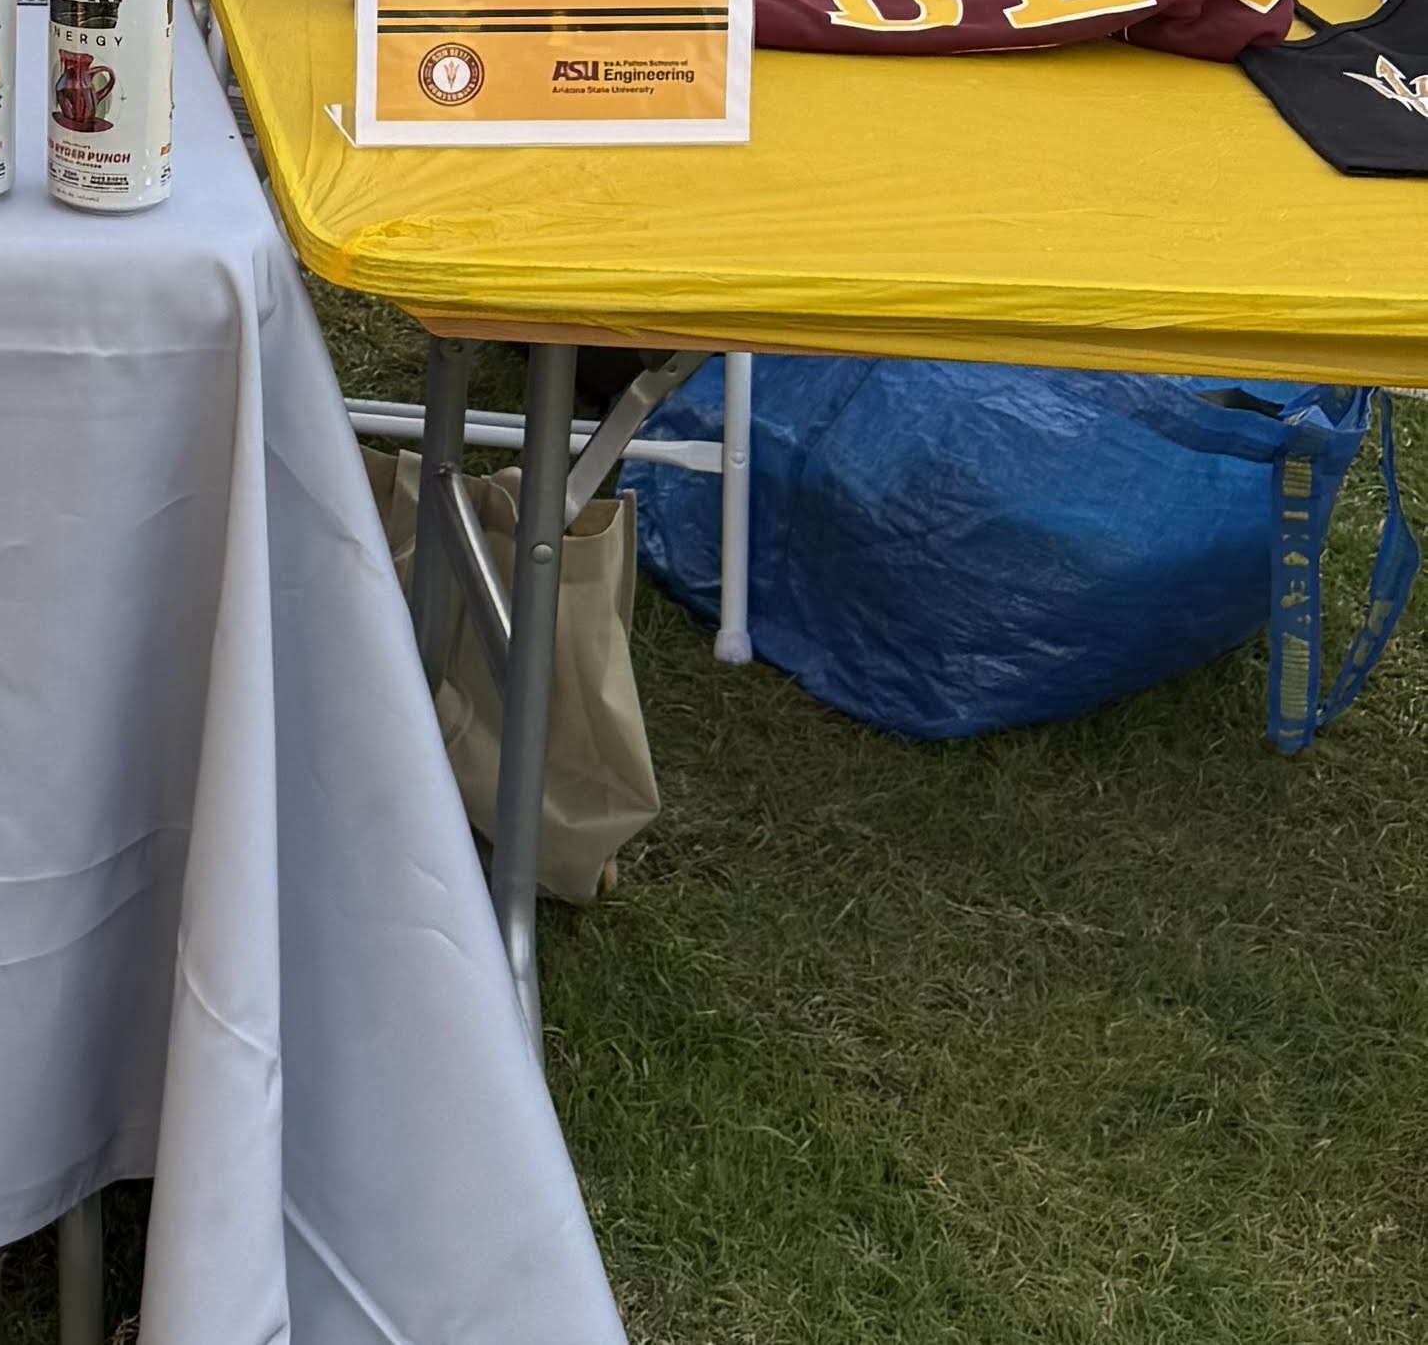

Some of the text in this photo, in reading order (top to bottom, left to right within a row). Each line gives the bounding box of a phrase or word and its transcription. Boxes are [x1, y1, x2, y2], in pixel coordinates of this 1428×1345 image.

[552, 60, 599, 81] ASU
[604, 68, 694, 83] Engineering
[587, 86, 609, 94] State
[88, 153, 131, 163] PUNCH
